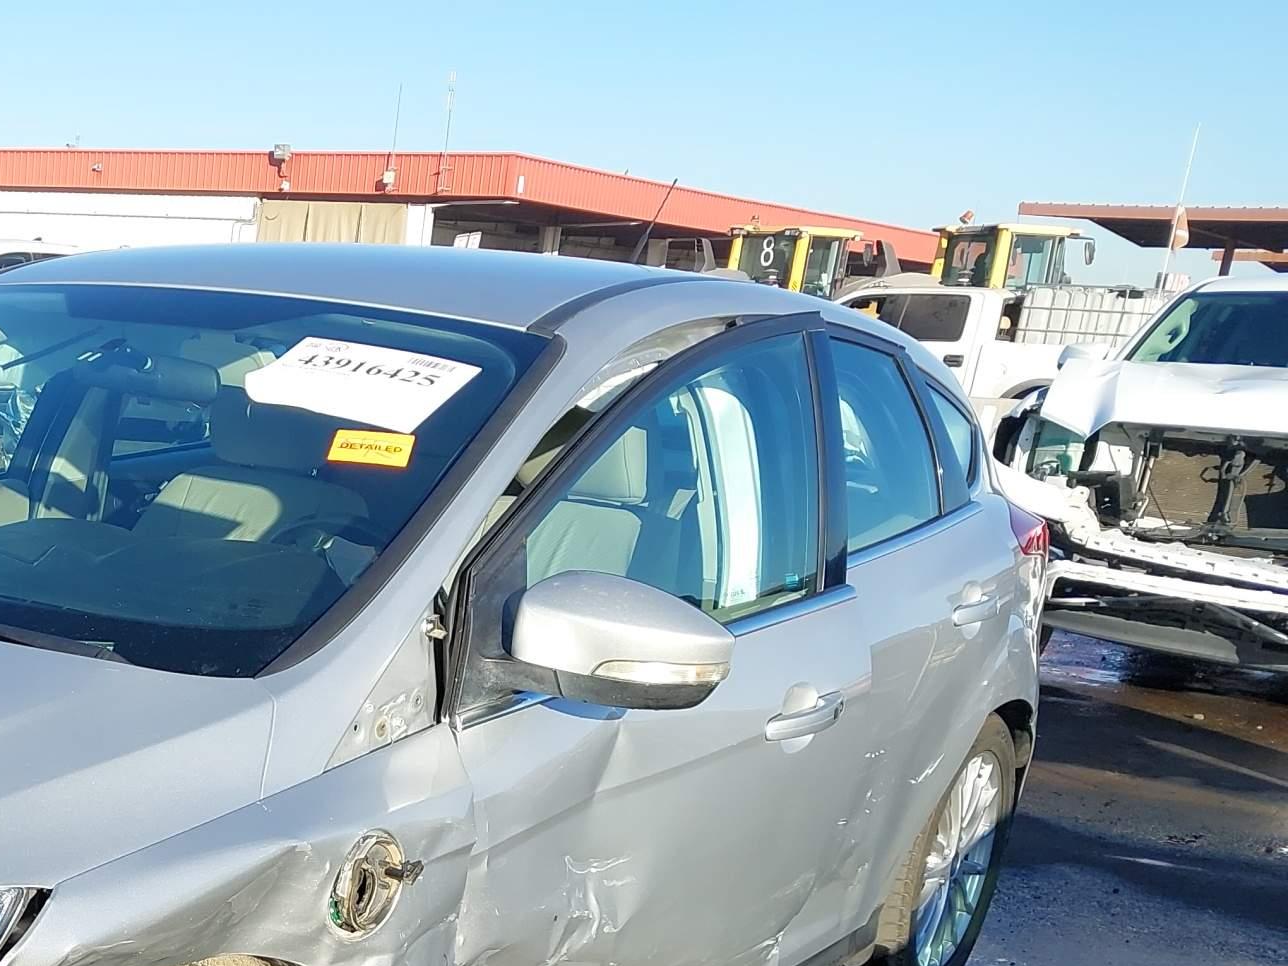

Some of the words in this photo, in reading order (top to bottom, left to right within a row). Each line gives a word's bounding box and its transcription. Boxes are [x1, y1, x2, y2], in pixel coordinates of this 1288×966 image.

[760, 236, 775, 267] 8
[298, 354, 441, 387] 43916425
[339, 441, 403, 454] DETAILED
